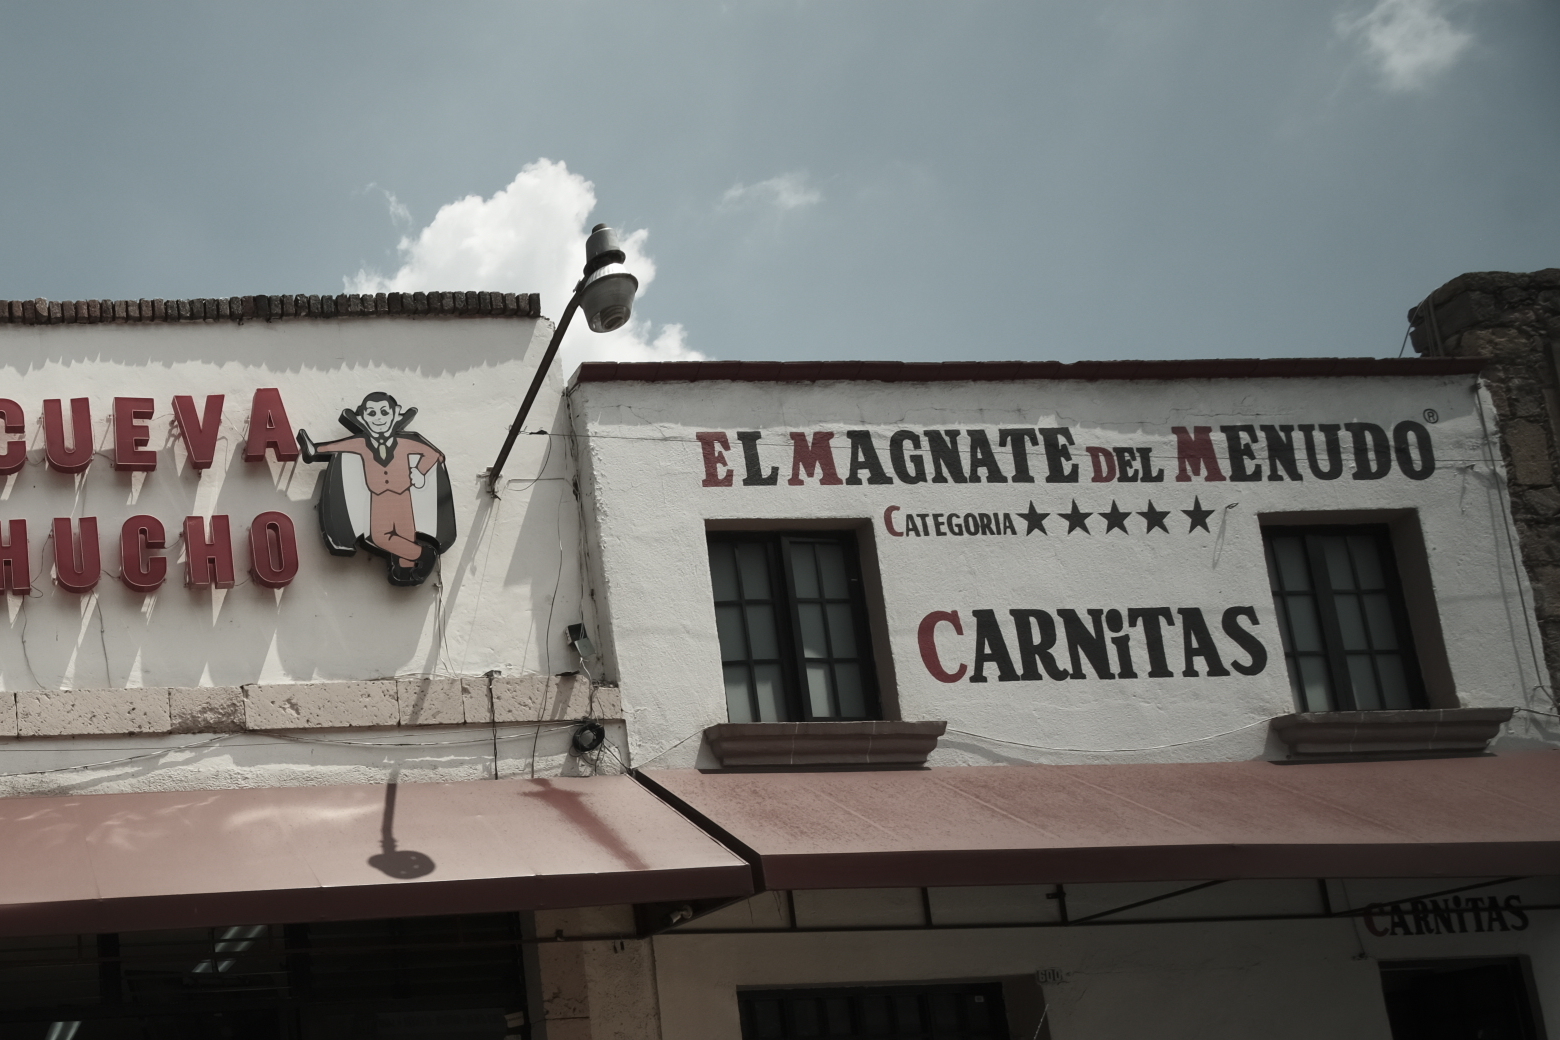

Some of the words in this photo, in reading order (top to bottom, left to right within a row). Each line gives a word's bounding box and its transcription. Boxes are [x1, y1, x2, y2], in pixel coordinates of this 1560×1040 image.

[696, 430, 780, 488] EL
[787, 426, 1081, 486] MAGNATE
[1085, 445, 1165, 484] DEL
[883, 505, 1018, 539] CATEGORIA
